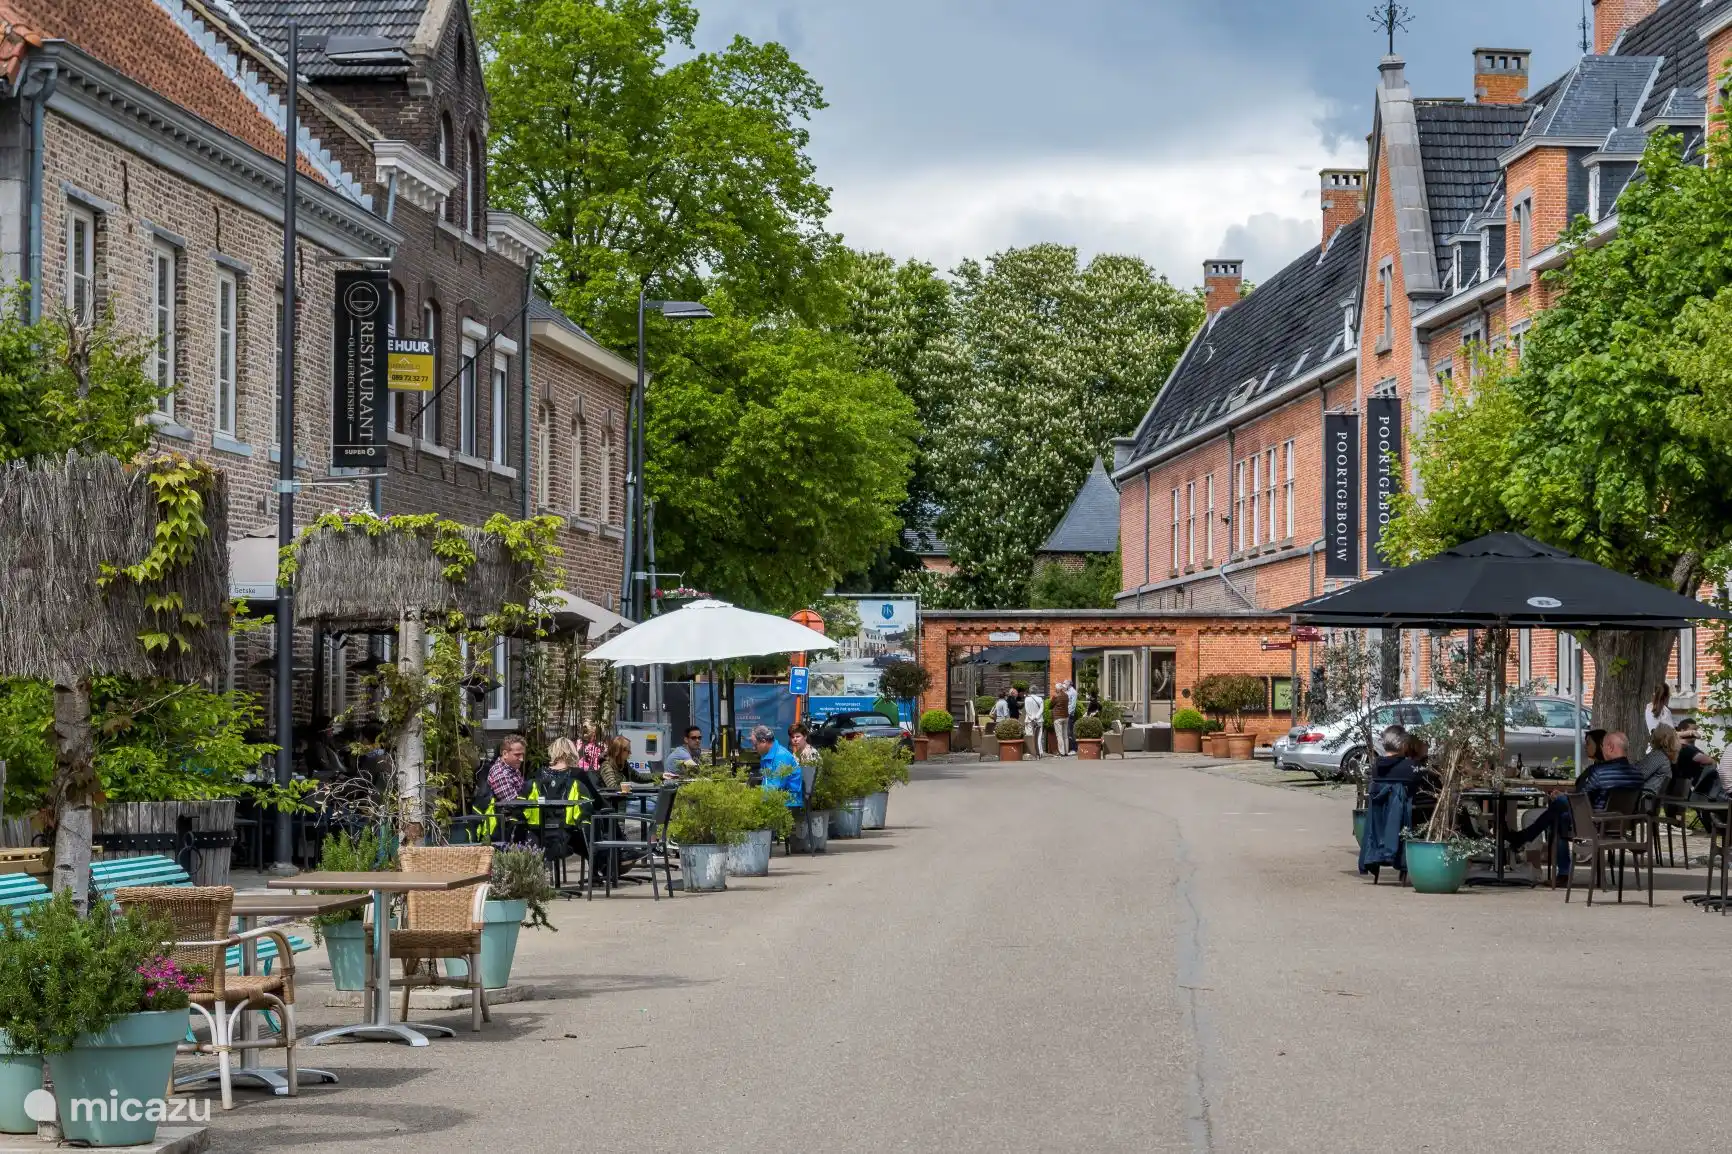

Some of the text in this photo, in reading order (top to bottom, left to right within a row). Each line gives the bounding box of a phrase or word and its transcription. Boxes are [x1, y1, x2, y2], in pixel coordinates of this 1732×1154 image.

[347, 337, 356, 421] OUD GERECHTSHOF
[360, 321, 375, 441] RESTAURANT
[395, 340, 430, 352] HUUR
[1336, 431, 1348, 561] POORTGEBOUW
[1378, 416, 1390, 539] POORTGEBO
